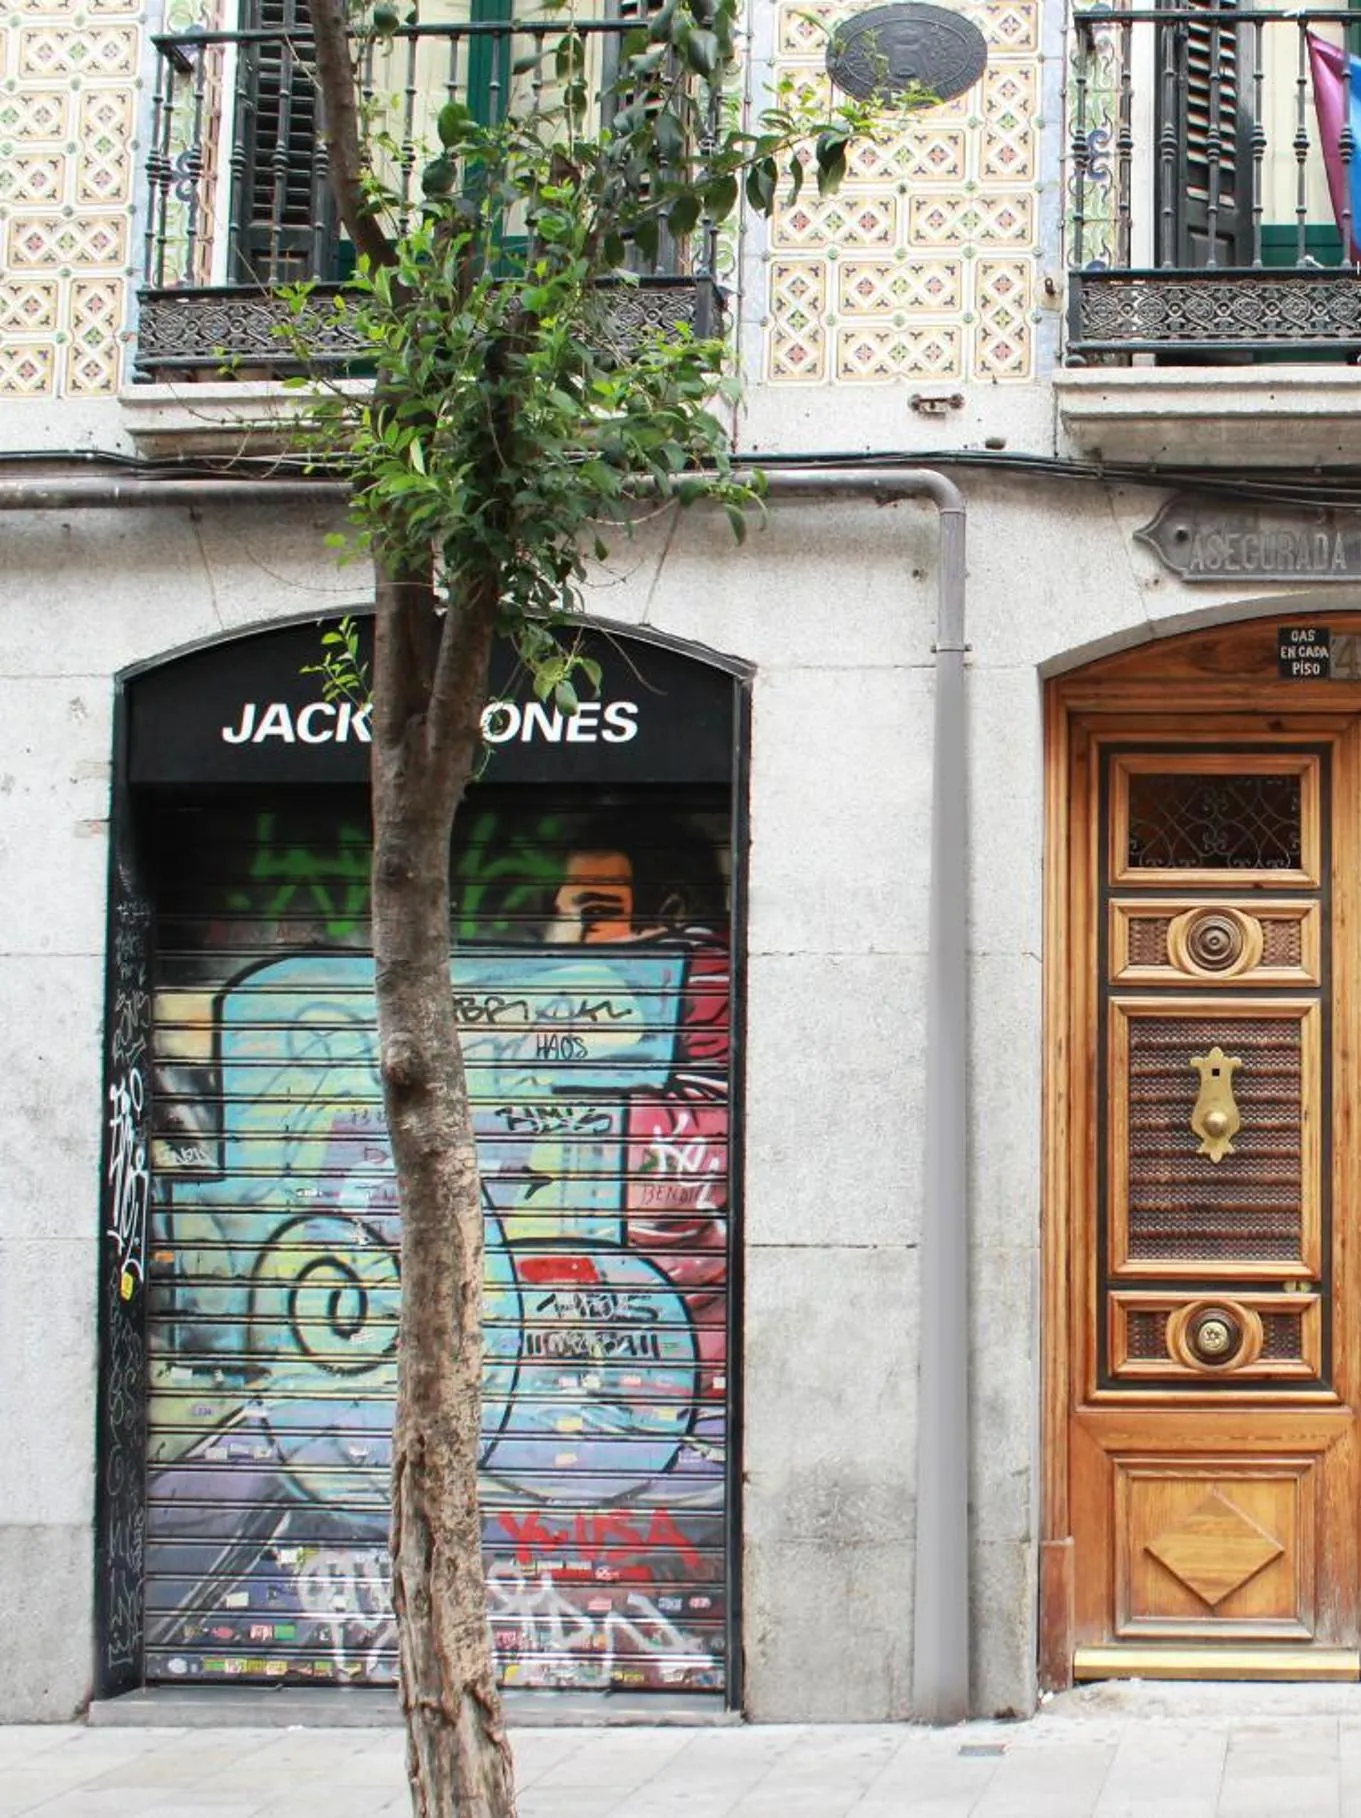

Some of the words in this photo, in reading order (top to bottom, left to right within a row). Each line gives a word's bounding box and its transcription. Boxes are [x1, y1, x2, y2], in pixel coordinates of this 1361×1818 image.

[1190, 531, 1347, 571] ASEGURADA
[1290, 630, 1317, 642] GAS
[1280, 646, 1297, 658] EN
[1298, 645, 1329, 658] CADA
[222, 703, 372, 744] JACK
